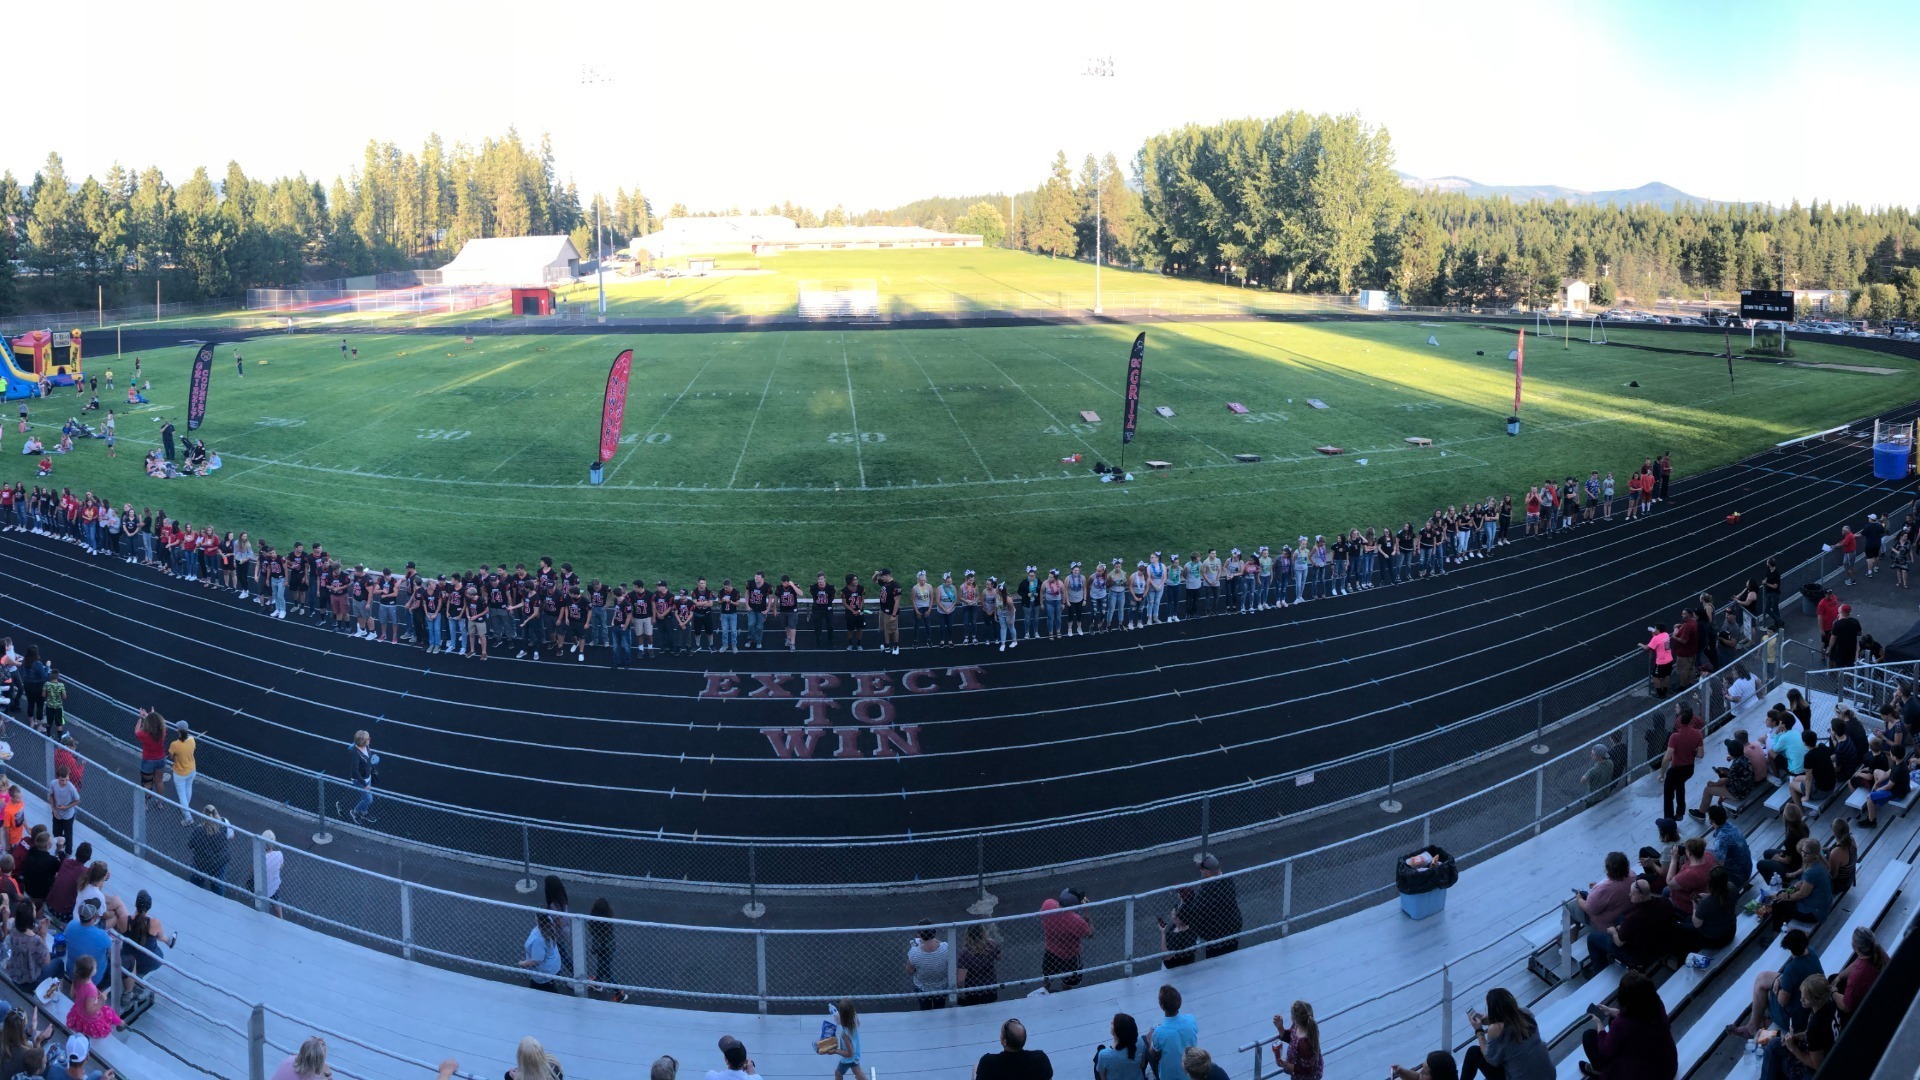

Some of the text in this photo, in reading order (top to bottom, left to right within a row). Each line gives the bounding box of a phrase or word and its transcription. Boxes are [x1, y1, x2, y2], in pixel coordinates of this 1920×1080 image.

[605, 376, 618, 446] NEWPORT
[1126, 369, 1139, 429] GRIZ
[826, 432, 887, 443] 50
[699, 665, 987, 698] EXPECT
[795, 699, 896, 726] TO
[760, 725, 922, 758] WIN
